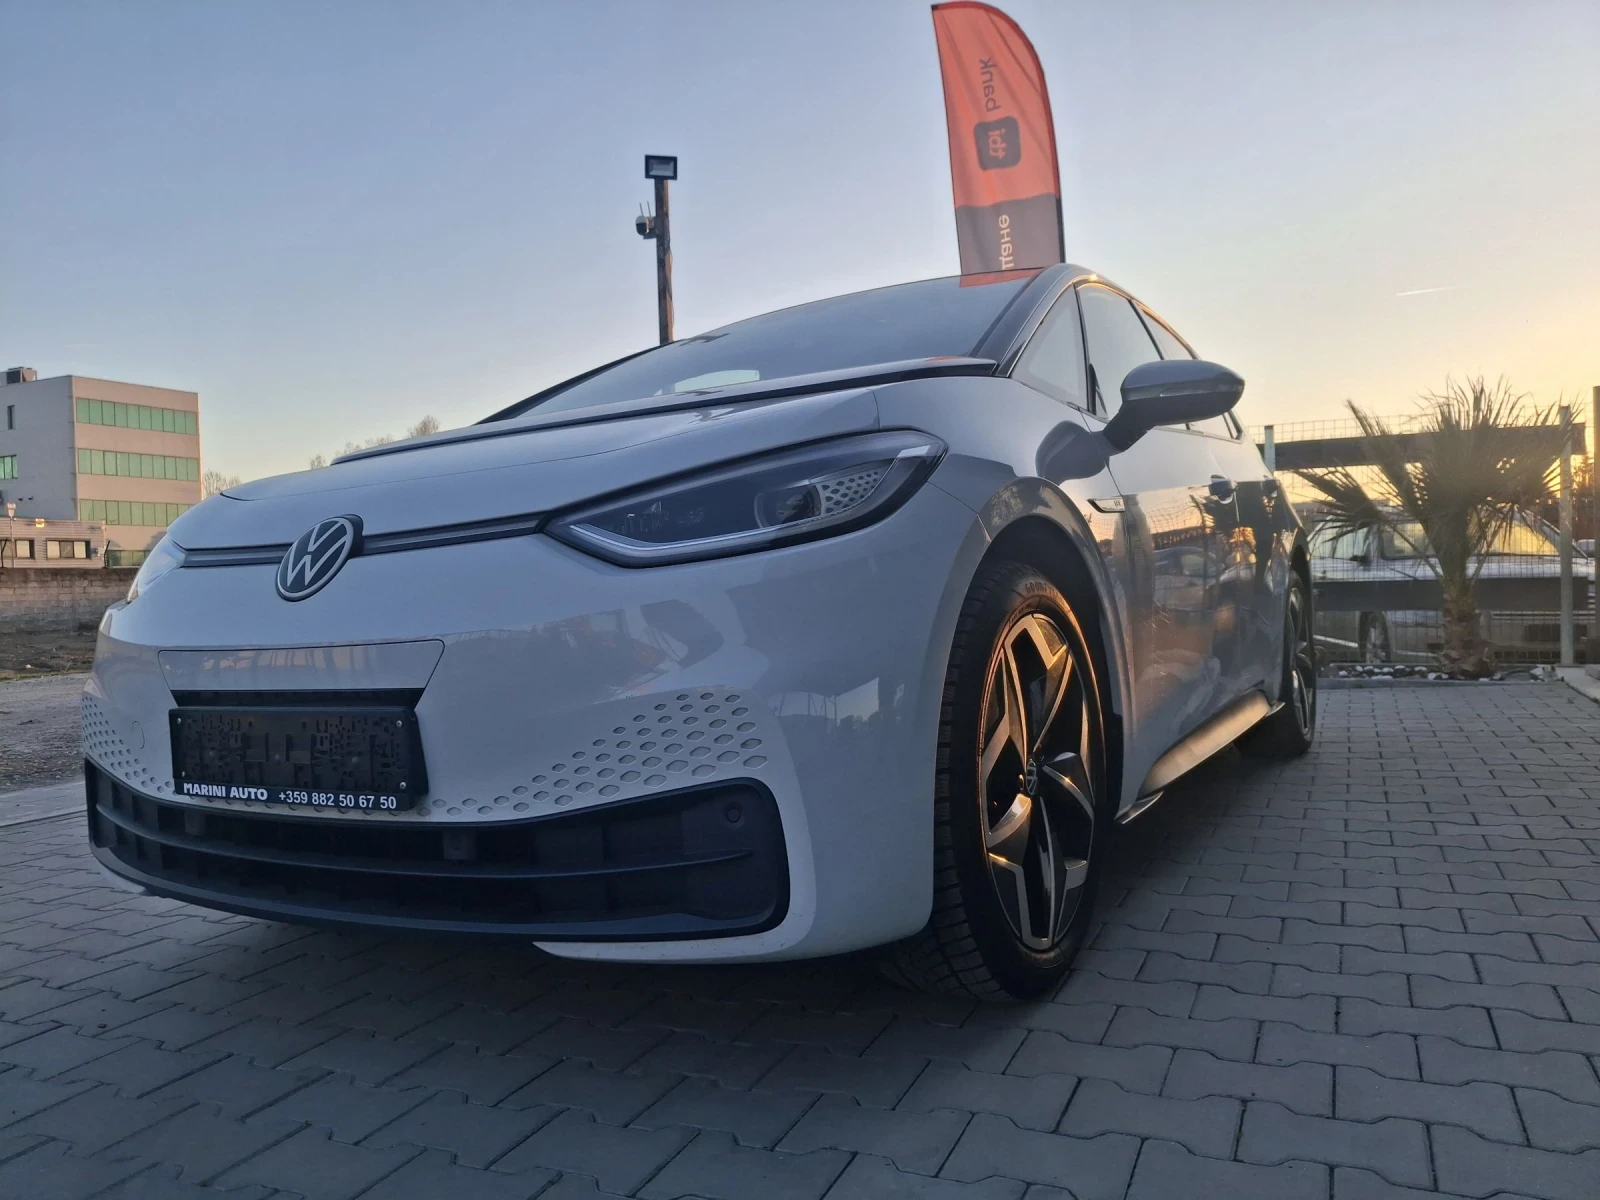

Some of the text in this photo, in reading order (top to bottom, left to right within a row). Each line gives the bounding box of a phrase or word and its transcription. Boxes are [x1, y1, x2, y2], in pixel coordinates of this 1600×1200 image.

[183, 782, 397, 809] MARINI AUTO +359 882 50 67 50
